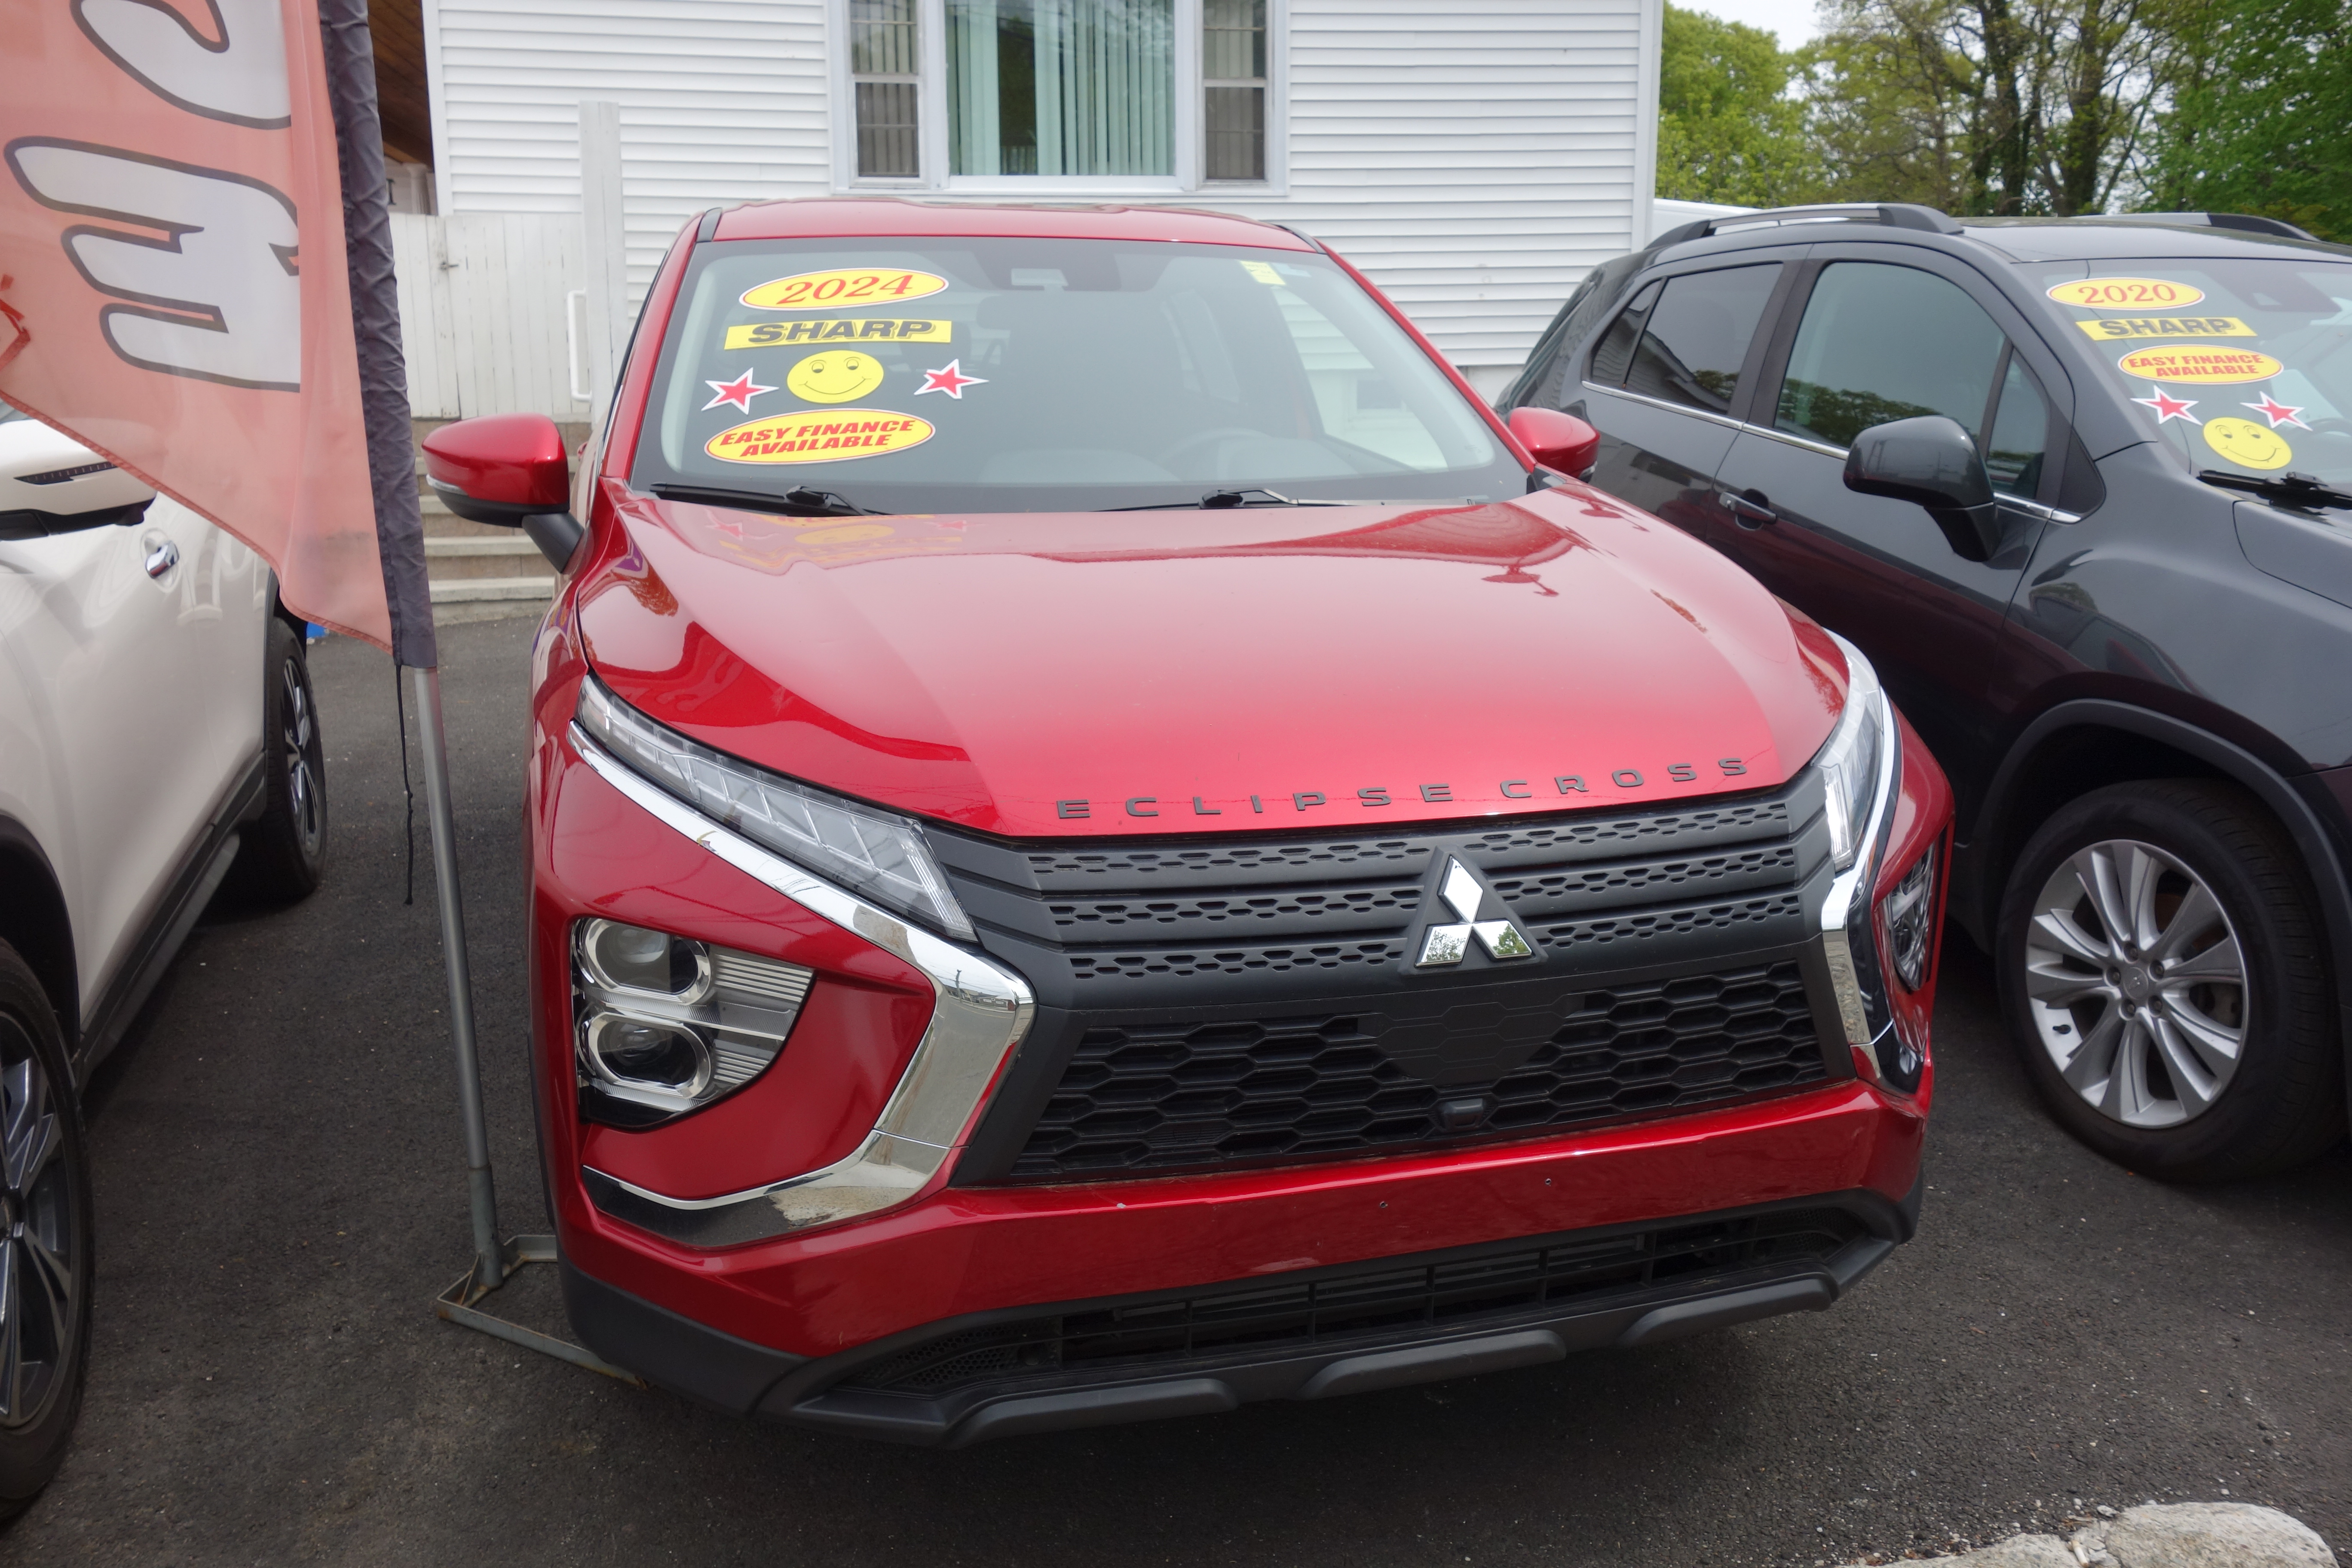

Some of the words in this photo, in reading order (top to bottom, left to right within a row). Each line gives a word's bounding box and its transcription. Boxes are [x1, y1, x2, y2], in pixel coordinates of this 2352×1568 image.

[776, 275, 913, 304] 2024
[2078, 284, 2176, 303] 2020
[748, 320, 935, 343] SHARP
[2098, 318, 2235, 336] SHARP
[2128, 356, 2177, 368] EASY
[2181, 355, 2264, 364] FINANCE
[2156, 365, 2259, 377] AVAILABLE
[720, 426, 793, 446] EASY
[795, 420, 916, 438] FINANCE
[739, 434, 892, 457] AVAILABLE
[1056, 784, 1454, 819] ECLIPSE
[1500, 758, 1748, 799] CROSS
